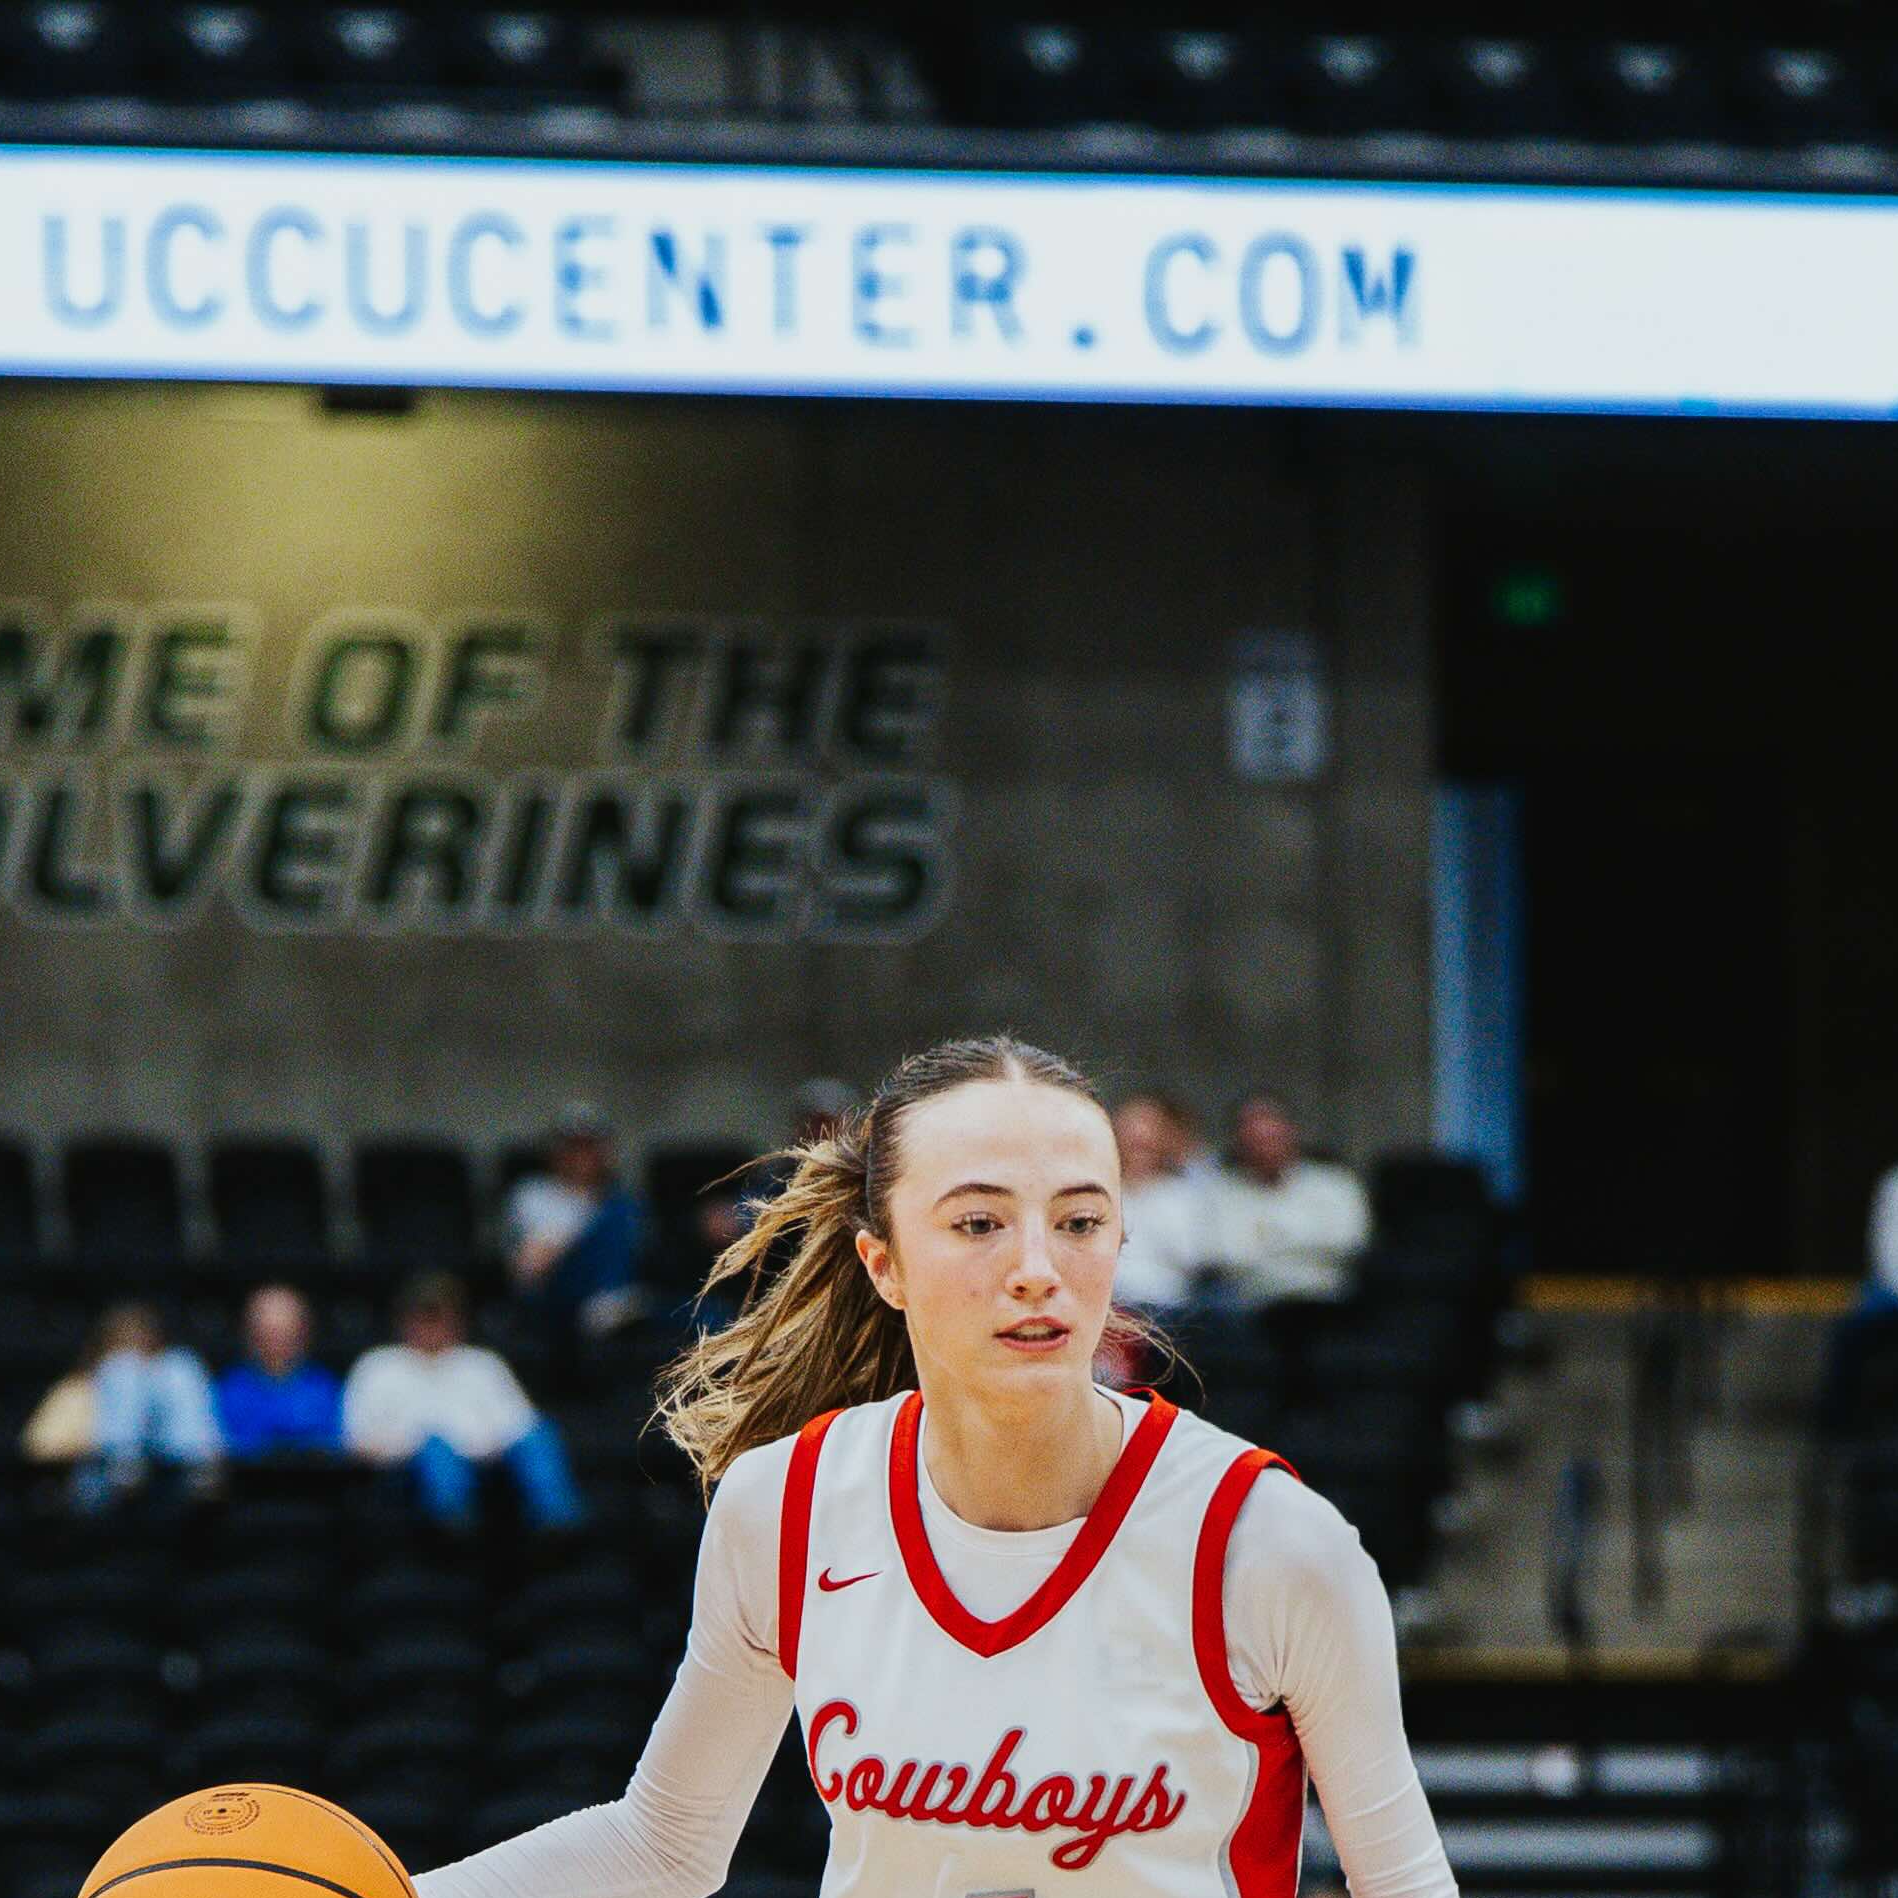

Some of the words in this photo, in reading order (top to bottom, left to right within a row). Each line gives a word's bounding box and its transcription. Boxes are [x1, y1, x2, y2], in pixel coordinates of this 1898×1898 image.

[41, 204, 1418, 357] UCCUCENTER.COM
[309, 624, 531, 752] OF
[614, 624, 937, 757] THE
[806, 1699, 1186, 1871] Cowboys
